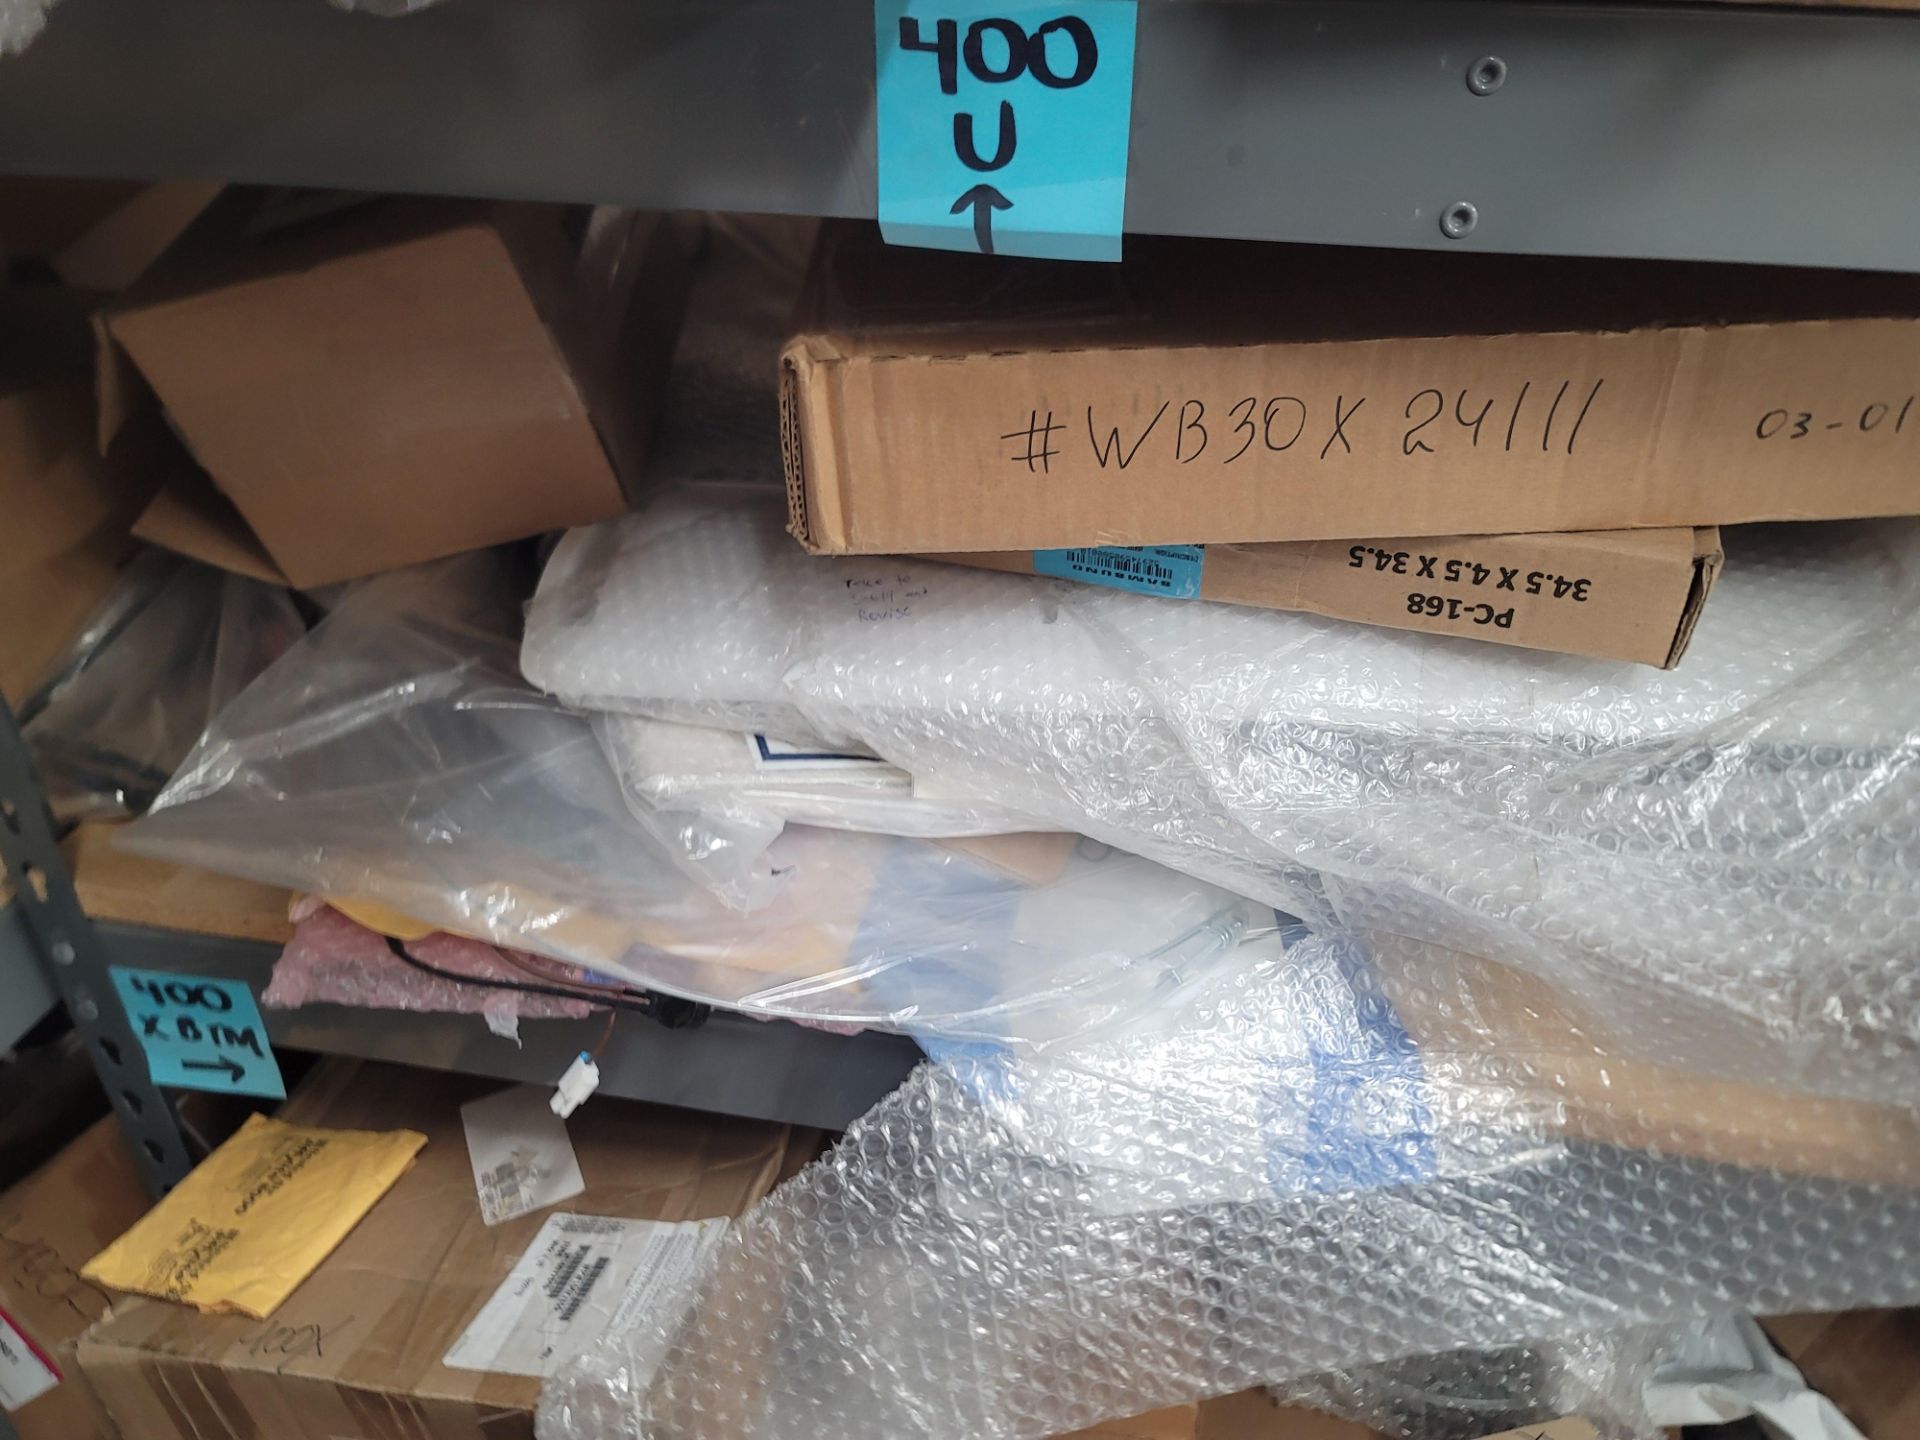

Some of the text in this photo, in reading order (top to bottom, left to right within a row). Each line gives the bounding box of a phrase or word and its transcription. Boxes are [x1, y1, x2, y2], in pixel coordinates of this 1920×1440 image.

[899, 16, 1099, 95] 400
[953, 100, 1017, 172] U
[1072, 564, 1171, 588] SAMSUNG
[1348, 544, 1592, 602] 34.5 X 4.5 X 34.5
[1406, 592, 1515, 628] PC-168
[130, 974, 233, 1012] 400
[138, 1013, 266, 1059] X BTM
